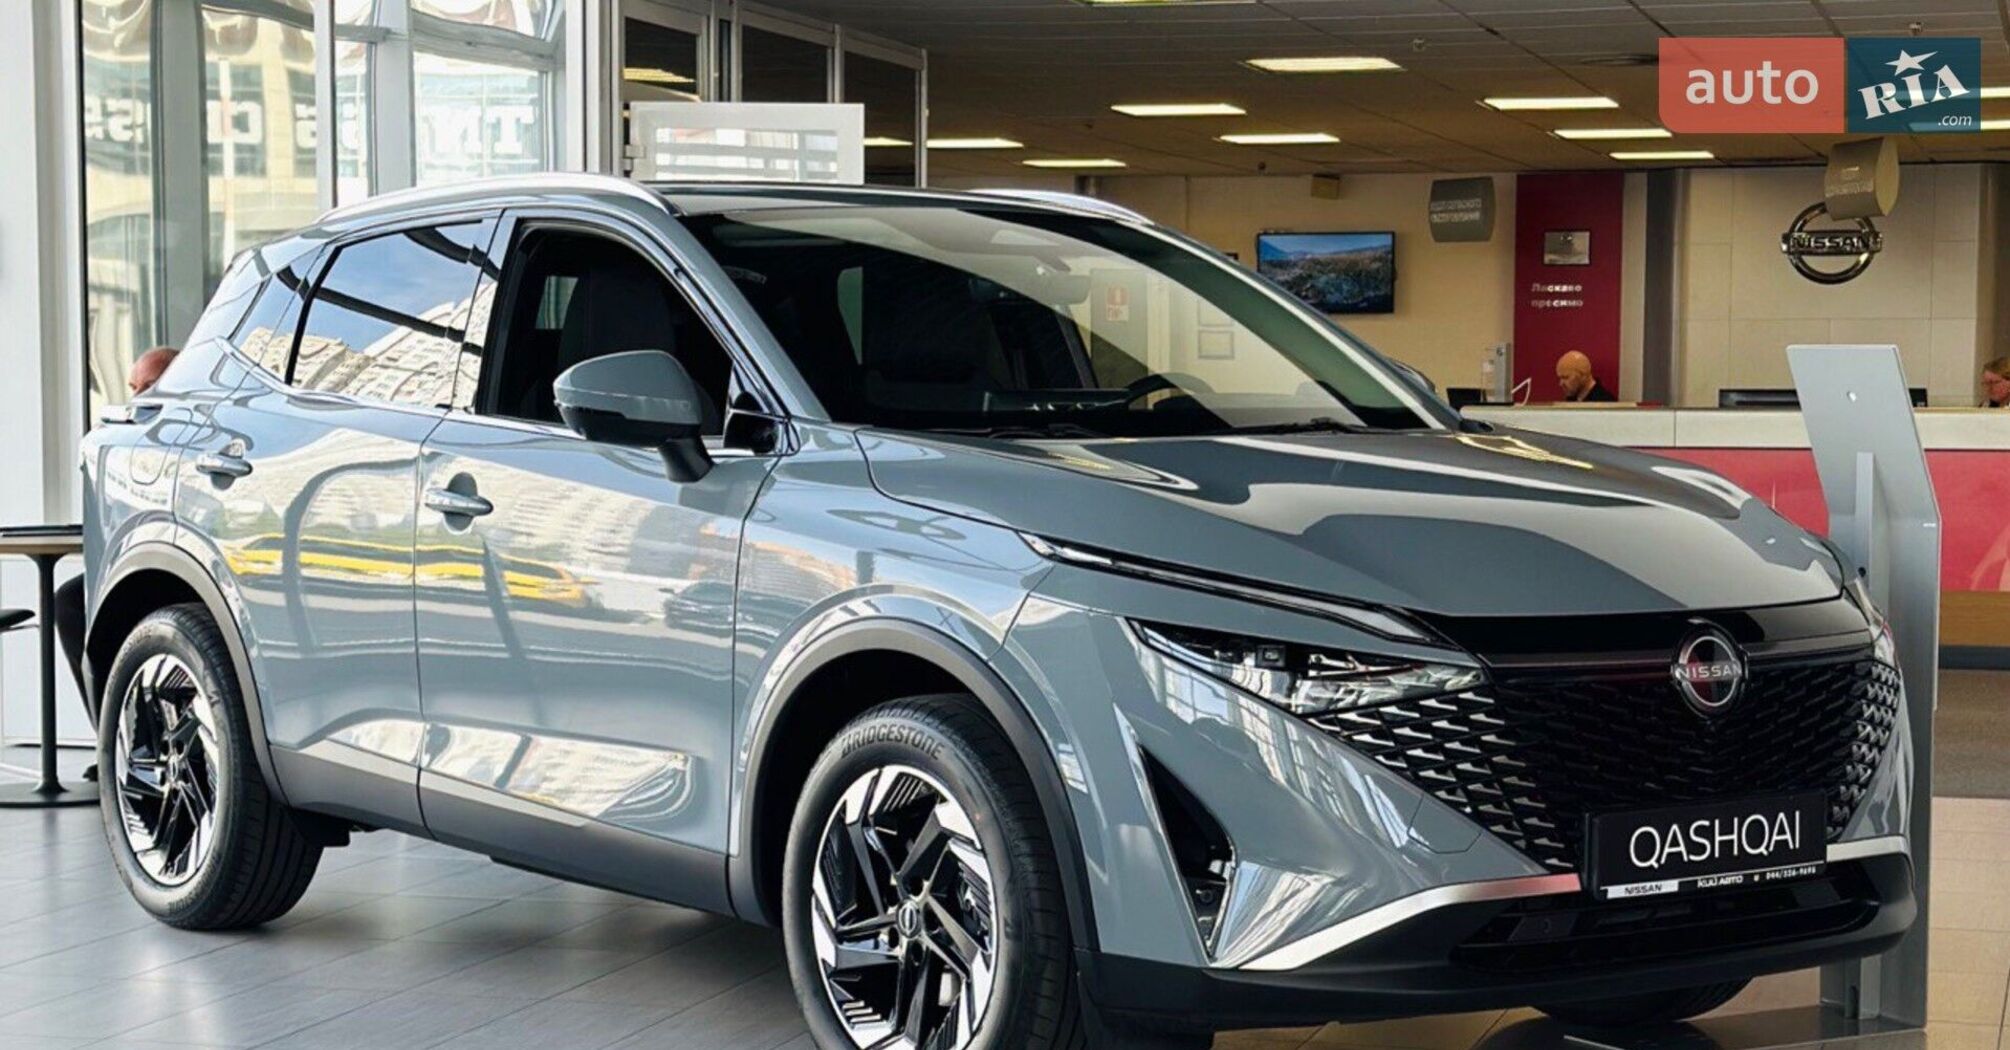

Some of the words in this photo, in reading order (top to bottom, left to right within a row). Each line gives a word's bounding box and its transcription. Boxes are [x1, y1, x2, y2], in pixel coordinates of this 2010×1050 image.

[1791, 235, 1873, 251] NISSAN
[1675, 663, 1742, 679] NISSAN
[841, 723, 945, 760] BRIDGESTONE
[1629, 810, 1800, 869] QASHQAI
[1624, 884, 1663, 895] NISSAN
